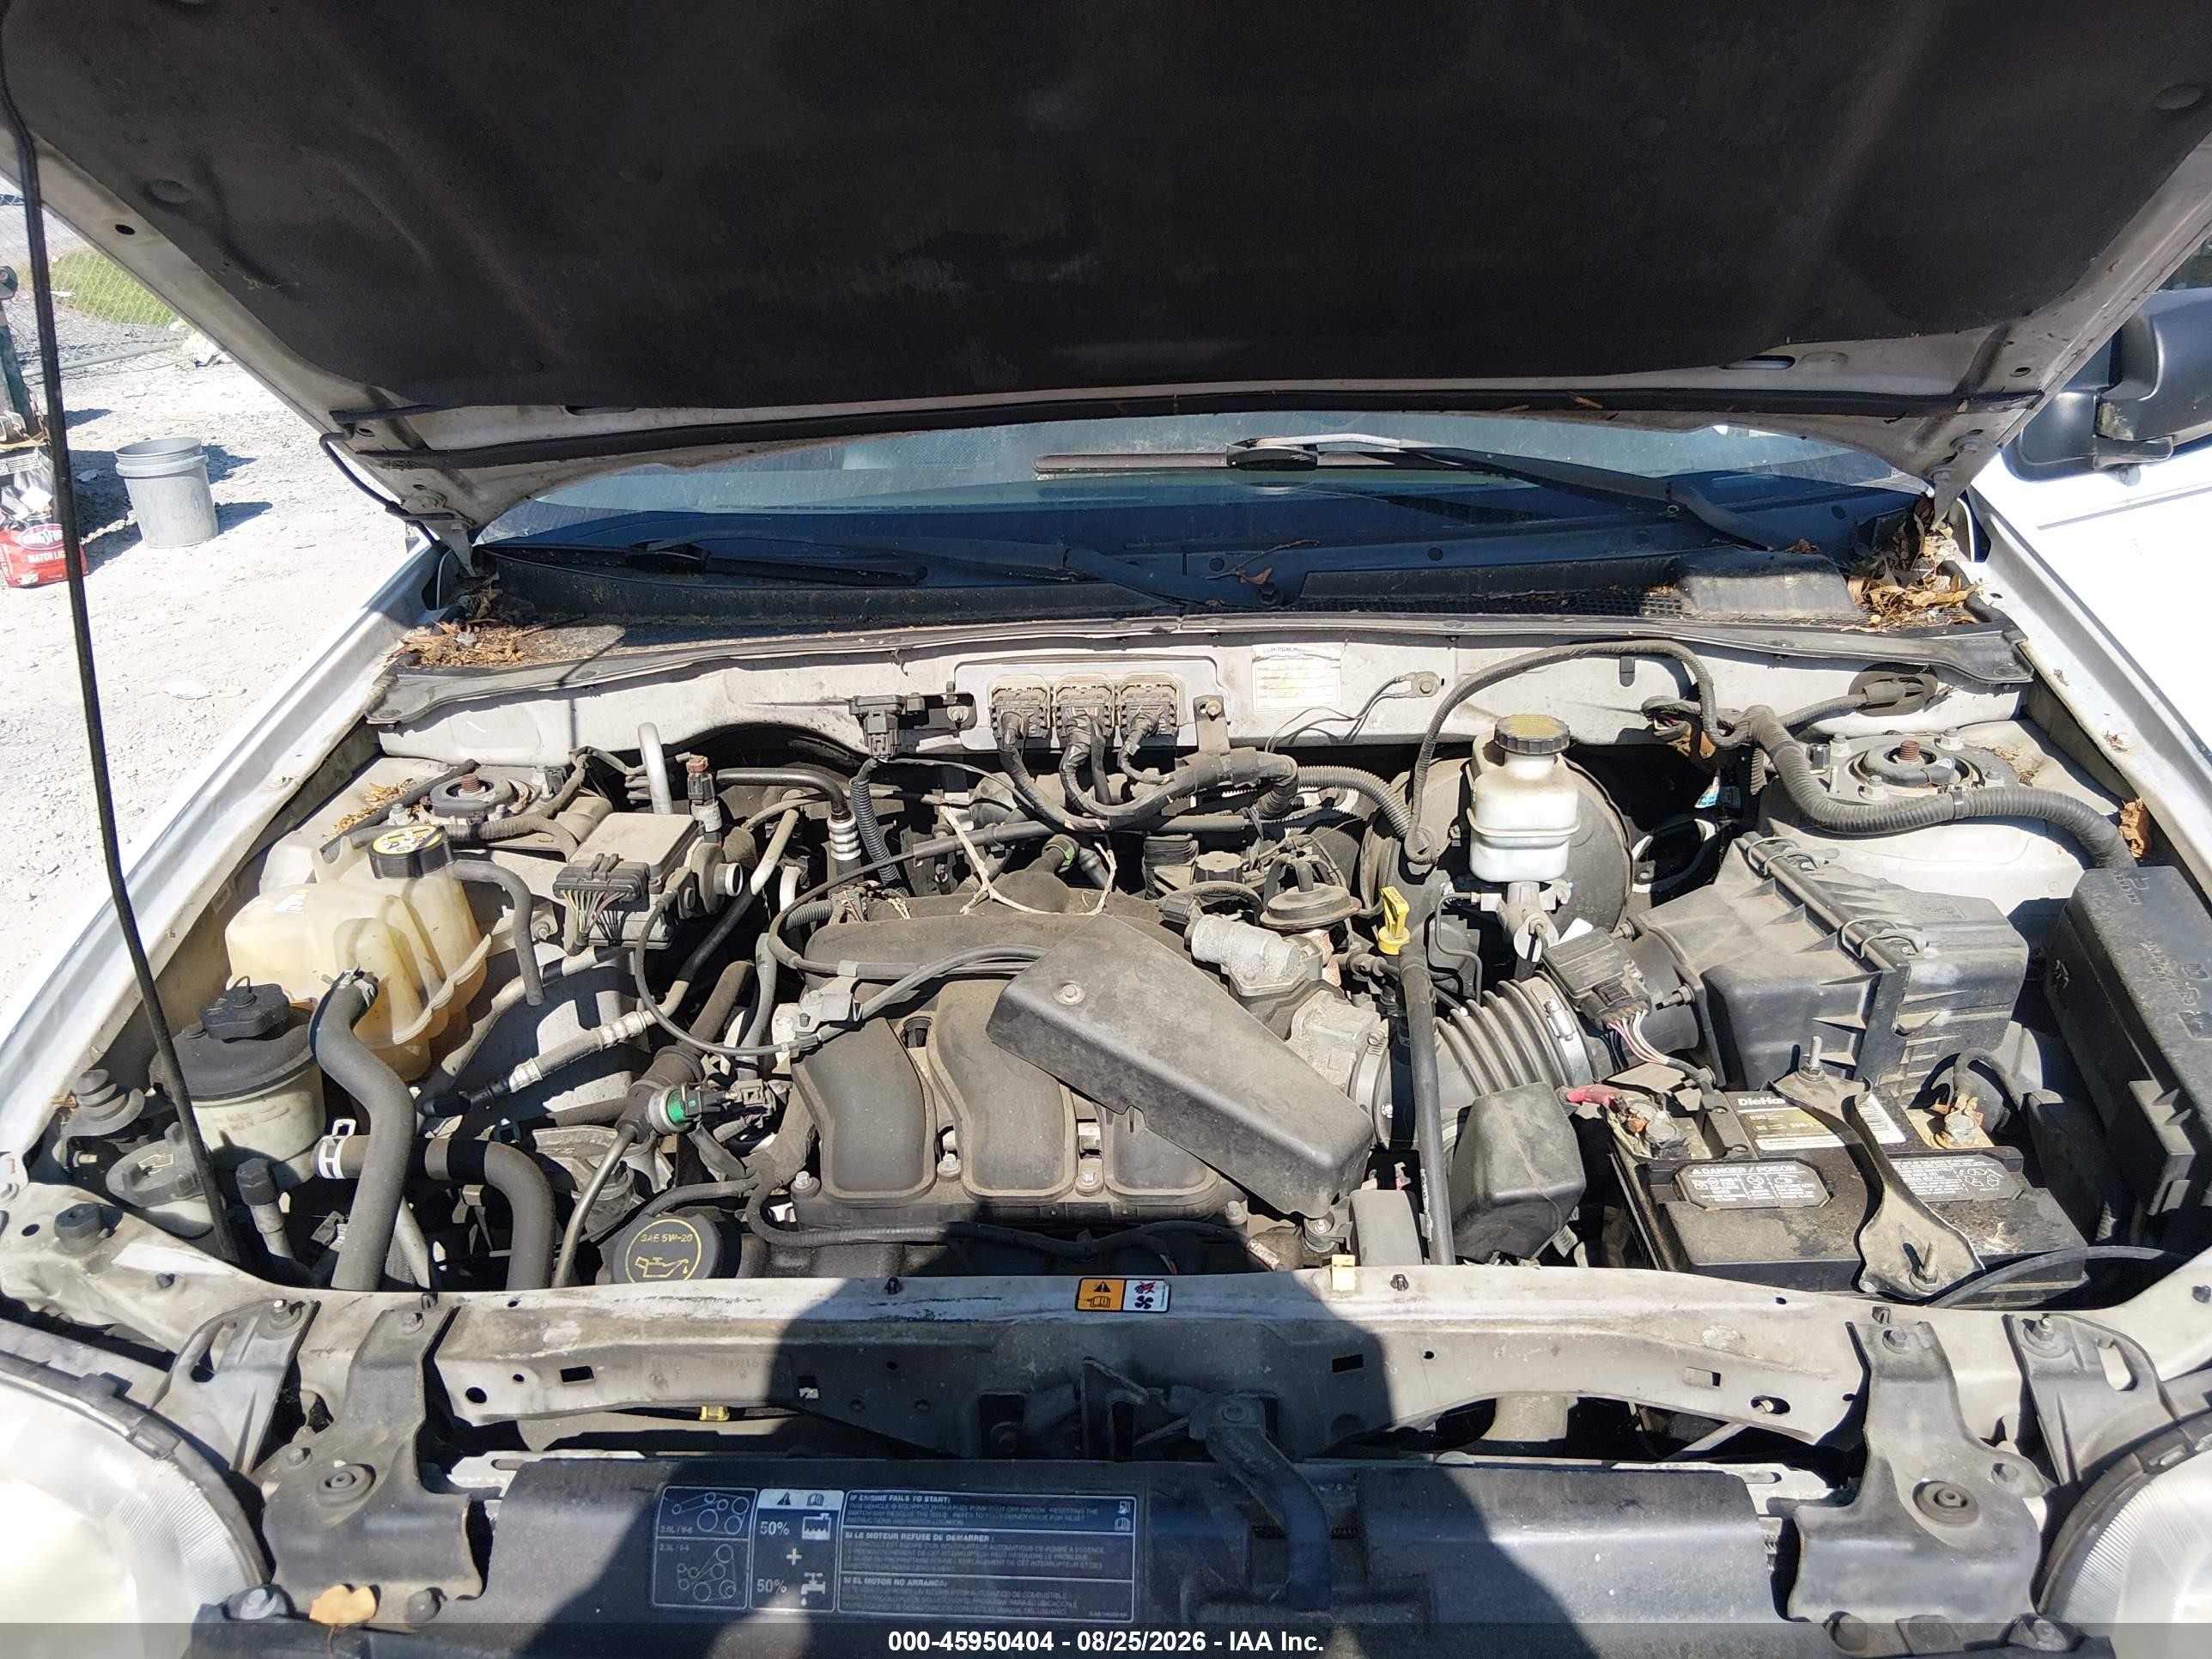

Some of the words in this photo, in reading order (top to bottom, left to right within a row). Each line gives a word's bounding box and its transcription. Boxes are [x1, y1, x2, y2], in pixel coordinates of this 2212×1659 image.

[641, 1234, 660, 1243] SAE
[661, 1233, 693, 1243] 5W-20
[760, 1521, 790, 1535] 50%
[757, 1578, 787, 1594] 50%
